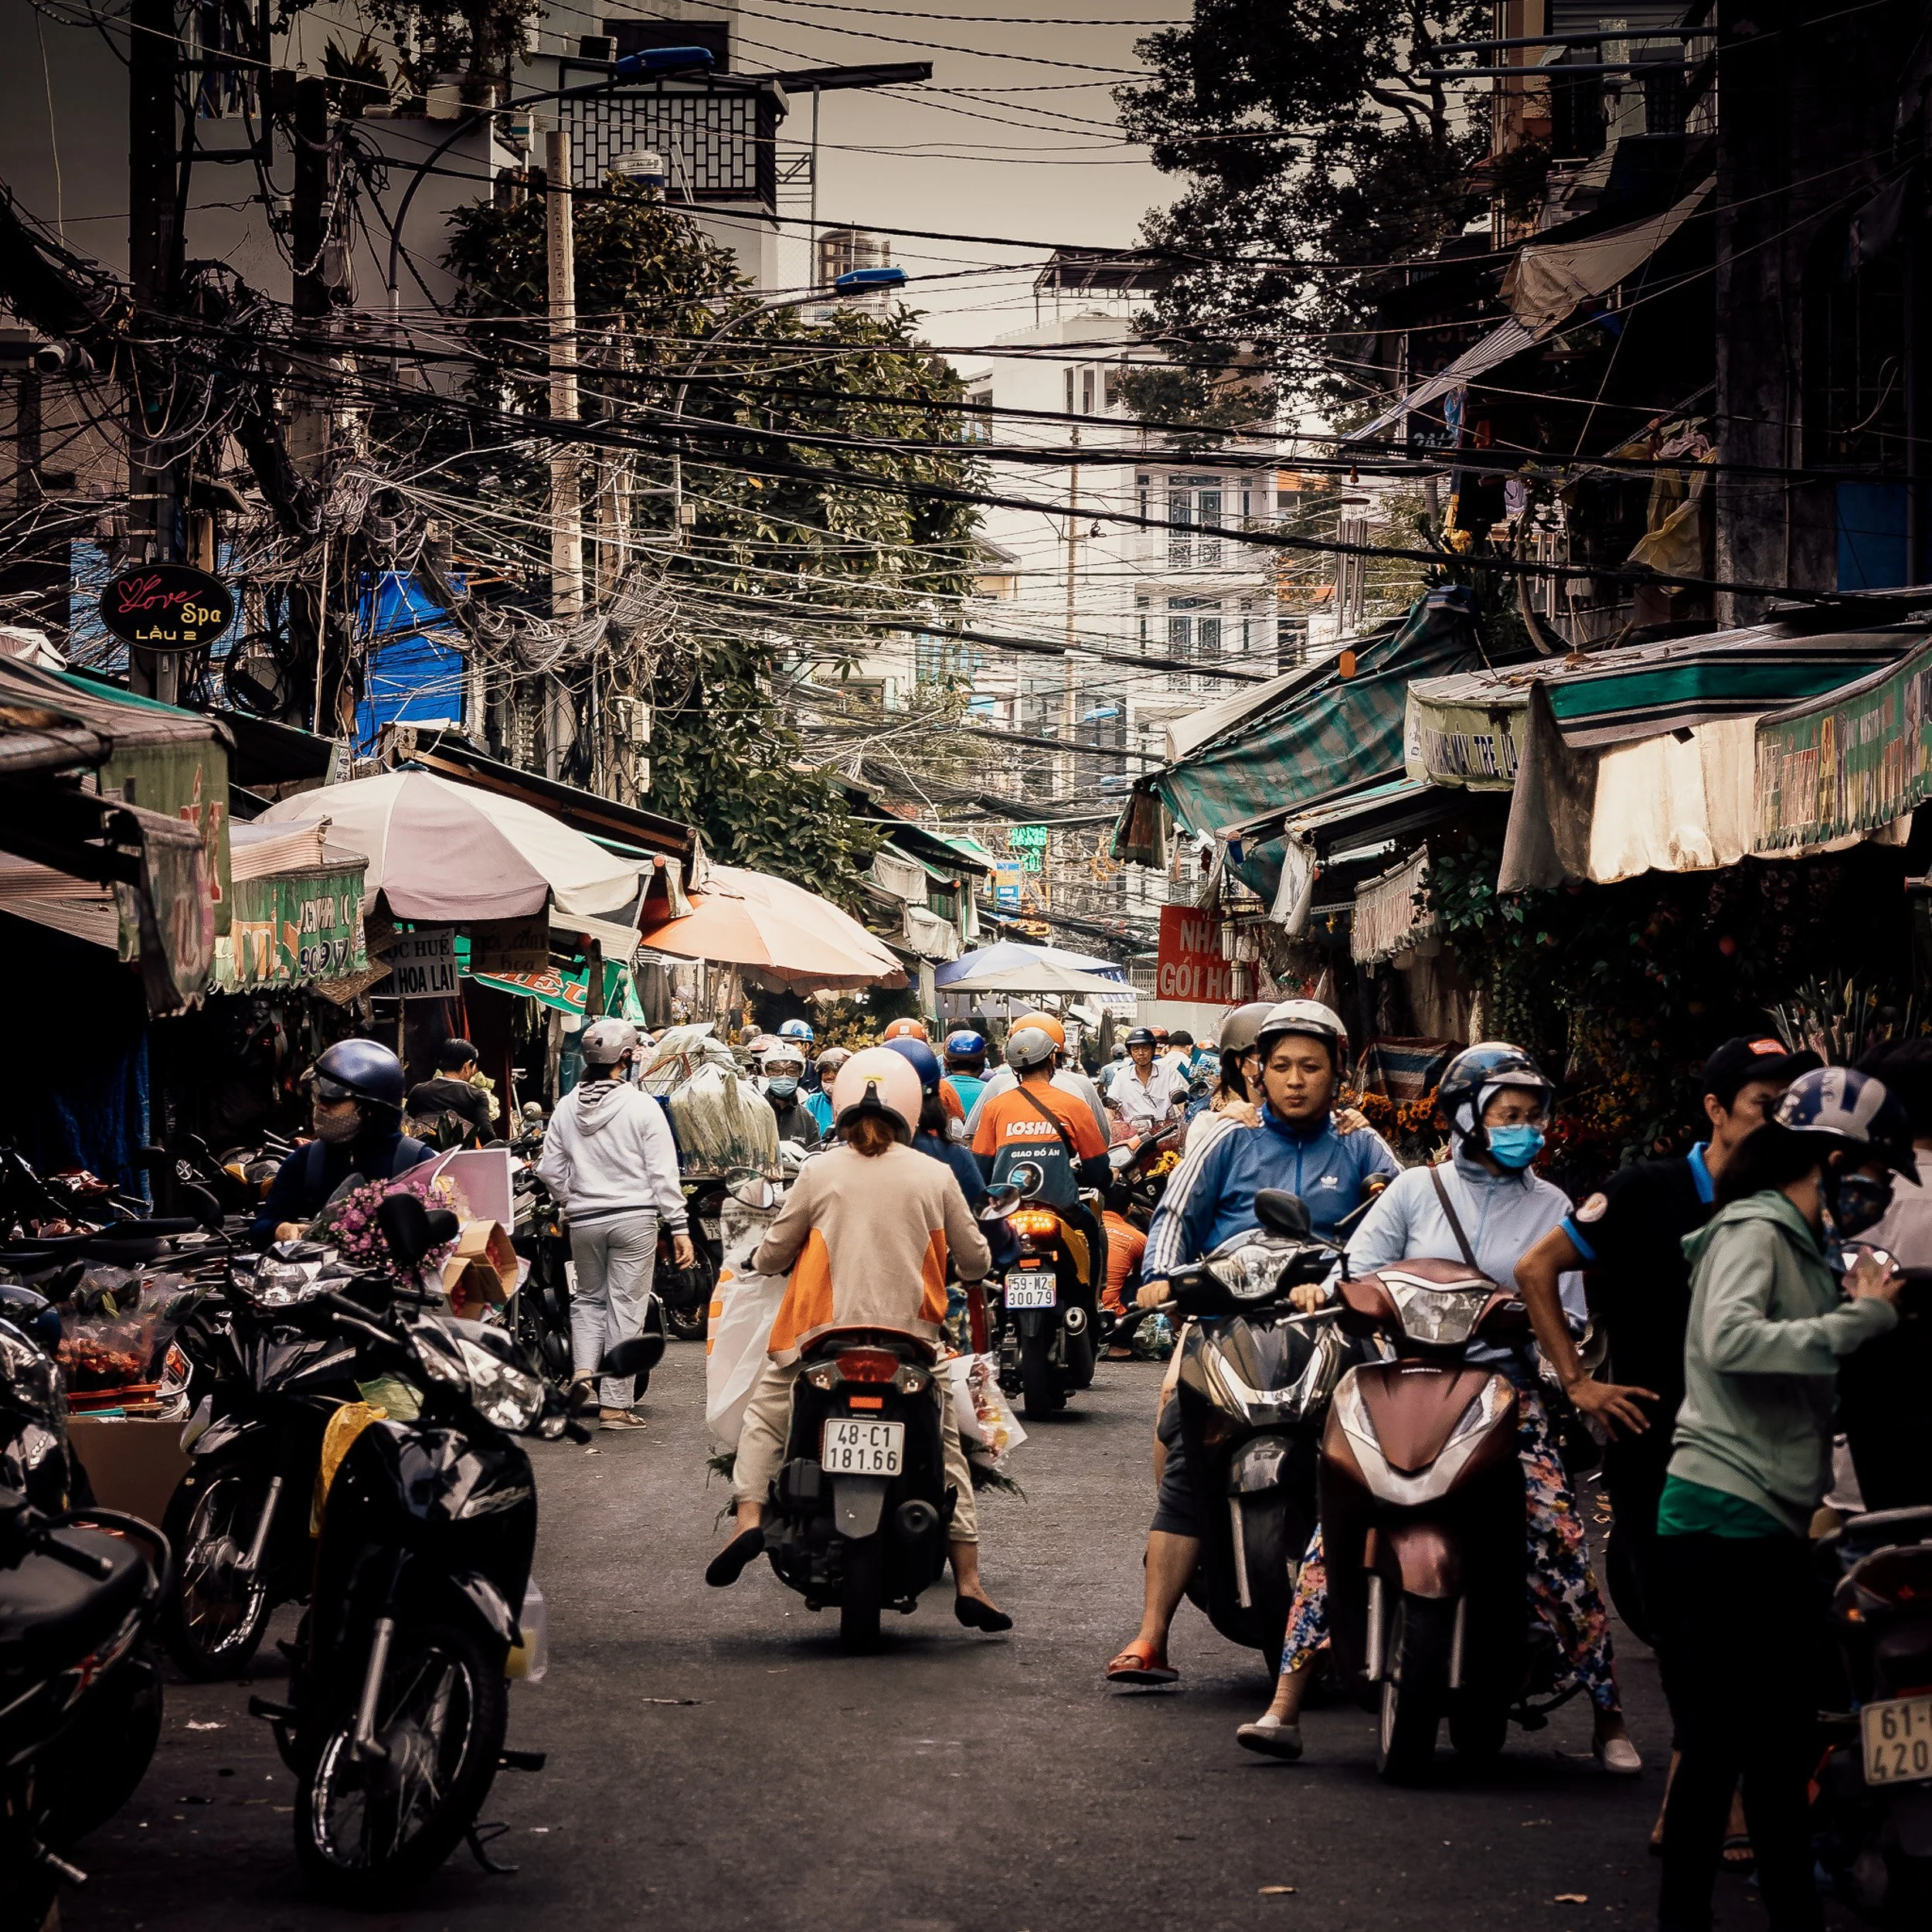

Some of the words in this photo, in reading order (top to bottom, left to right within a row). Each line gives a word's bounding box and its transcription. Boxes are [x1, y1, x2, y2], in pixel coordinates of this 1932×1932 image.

[118, 574, 203, 613] Love
[181, 602, 222, 626] Spa
[136, 624, 176, 641] LẦU
[183, 631, 197, 641] 2
[414, 932, 450, 957] HUẾ
[398, 965, 427, 994] HOA
[430, 957, 454, 991] LÀI
[1160, 956, 1200, 998] GÓI
[1011, 1150, 1032, 1158] GIAO
[1009, 1291, 1052, 1305] 300.79
[838, 1423, 890, 1447] 48-C1
[830, 1447, 897, 1471] 181.66
[1881, 1705, 1932, 1740] 61-
